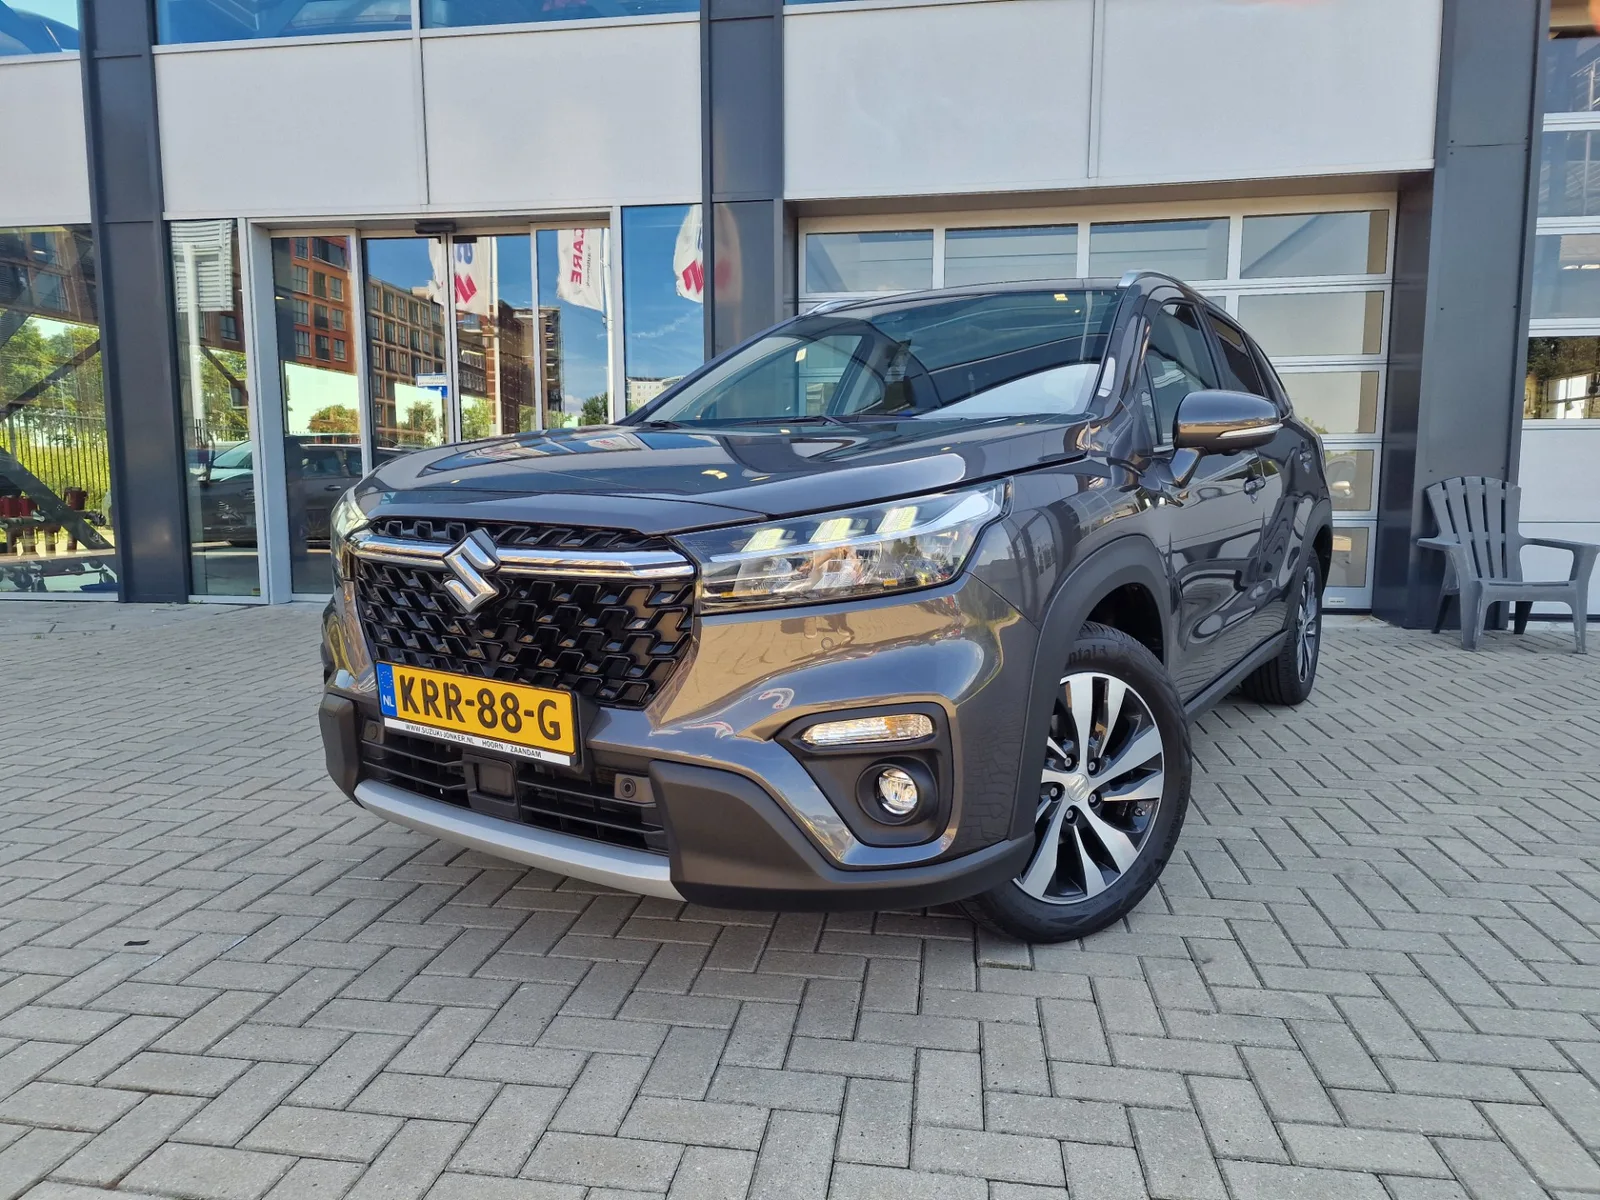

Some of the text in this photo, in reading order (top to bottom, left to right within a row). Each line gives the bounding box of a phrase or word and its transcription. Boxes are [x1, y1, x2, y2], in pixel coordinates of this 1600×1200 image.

[383, 694, 395, 707] NL
[399, 675, 561, 741] KRR-88-G
[482, 740, 504, 750] HOORN
[510, 746, 542, 758] ZAANDAM
